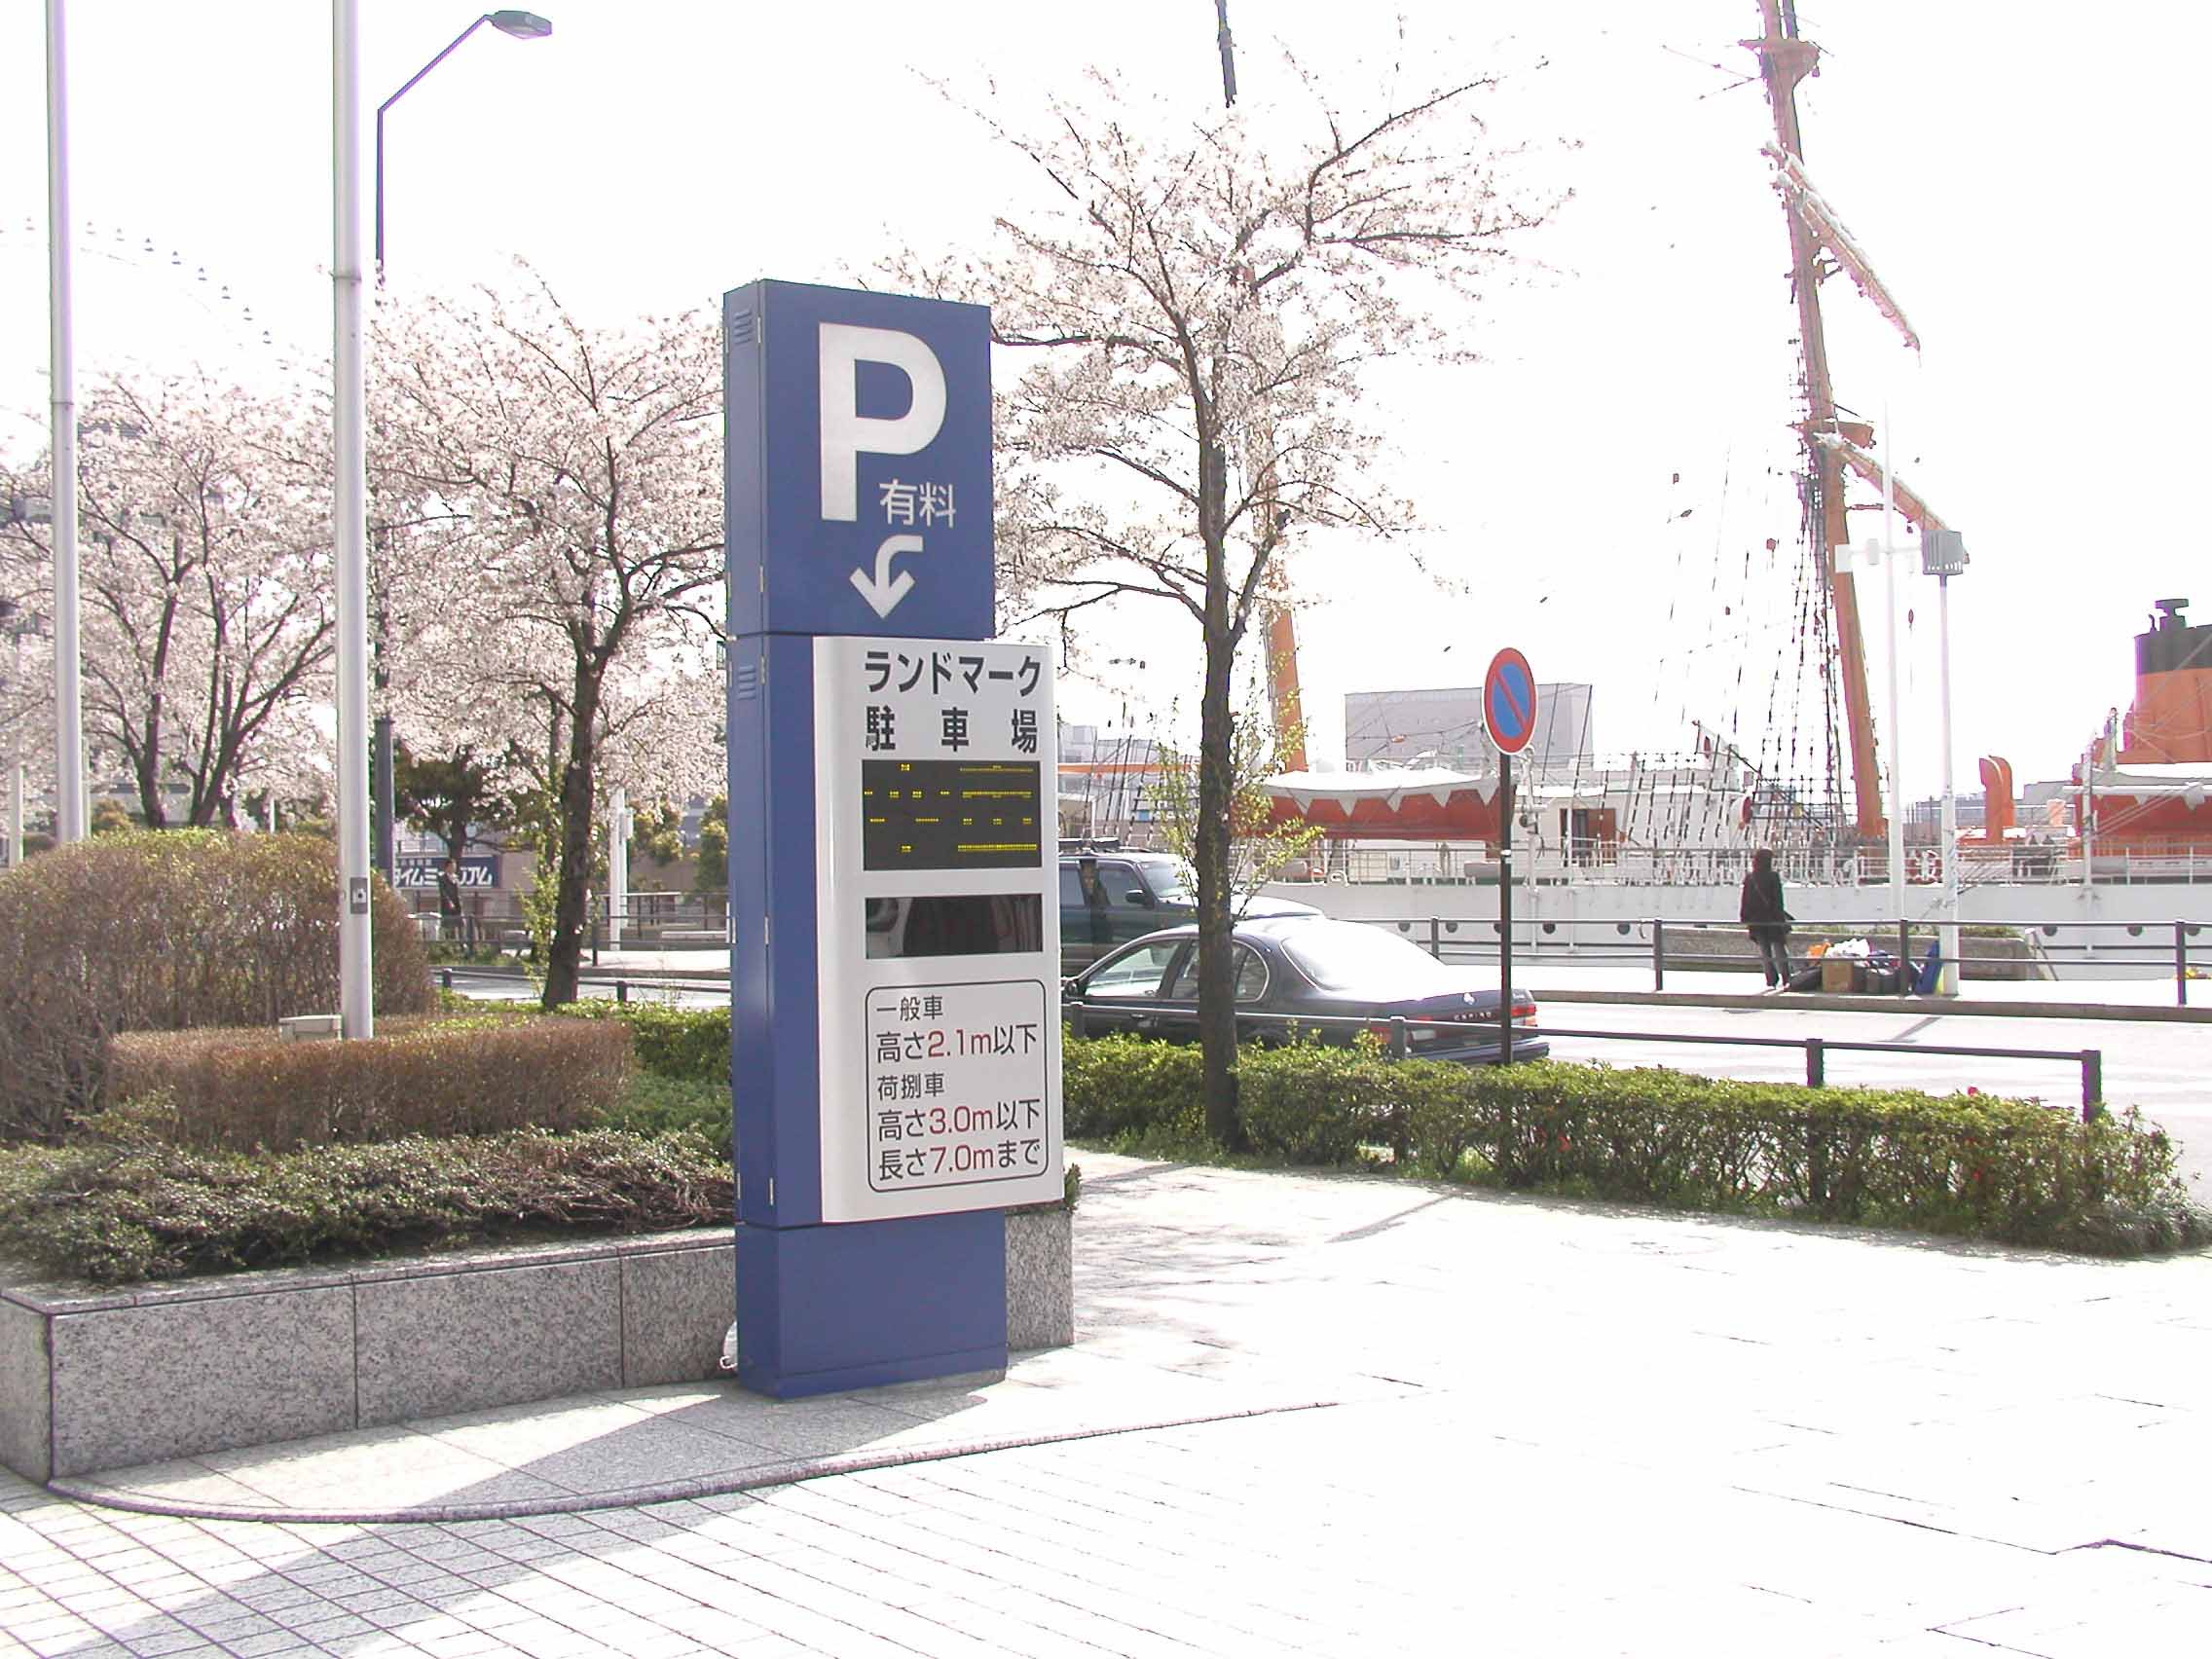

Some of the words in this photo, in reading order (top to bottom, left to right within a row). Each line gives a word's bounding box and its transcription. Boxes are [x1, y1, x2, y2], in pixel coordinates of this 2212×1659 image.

[819, 322, 947, 523] P
[879, 478, 956, 529] 有料
[865, 650, 1041, 697] ランドマーク
[865, 705, 1039, 754] 駐車場
[876, 995, 943, 1022] 一般車
[876, 1023, 1038, 1064] 高さ2.1m以下
[877, 1073, 945, 1101] 荷捌車
[878, 1098, 1041, 1142] 高さ3.0m以下
[879, 1138, 1041, 1182] 長さ7.0mまで
